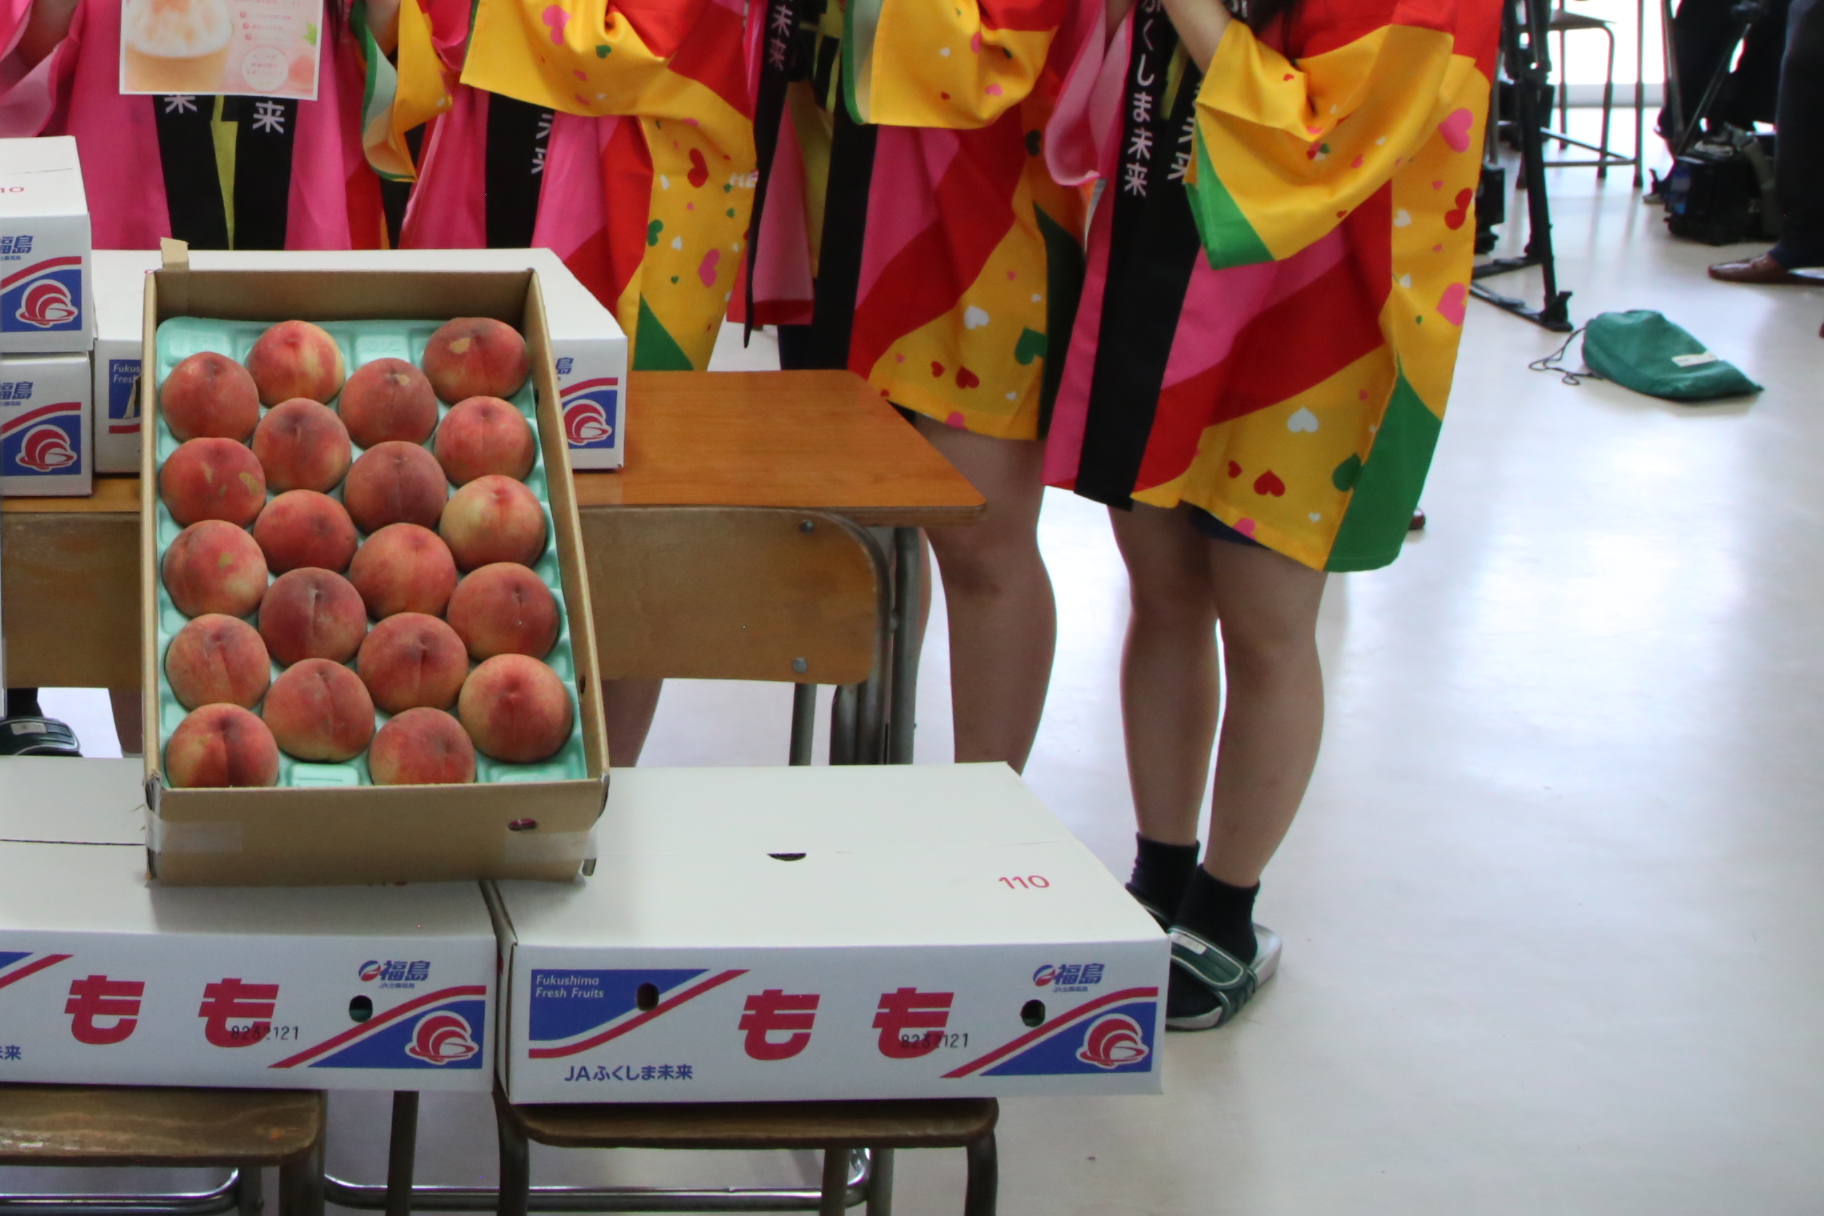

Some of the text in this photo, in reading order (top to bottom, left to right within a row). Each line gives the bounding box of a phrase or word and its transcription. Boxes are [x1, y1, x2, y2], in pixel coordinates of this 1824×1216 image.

[112, 363, 141, 374] Fukus
[998, 875, 1050, 889] 110
[380, 960, 431, 981] 福島
[1054, 963, 1105, 985] 福島
[535, 973, 600, 986] Fukushima
[535, 986, 604, 999] Fresh Fruits
[564, 1063, 694, 1083] JAふくしま未来
